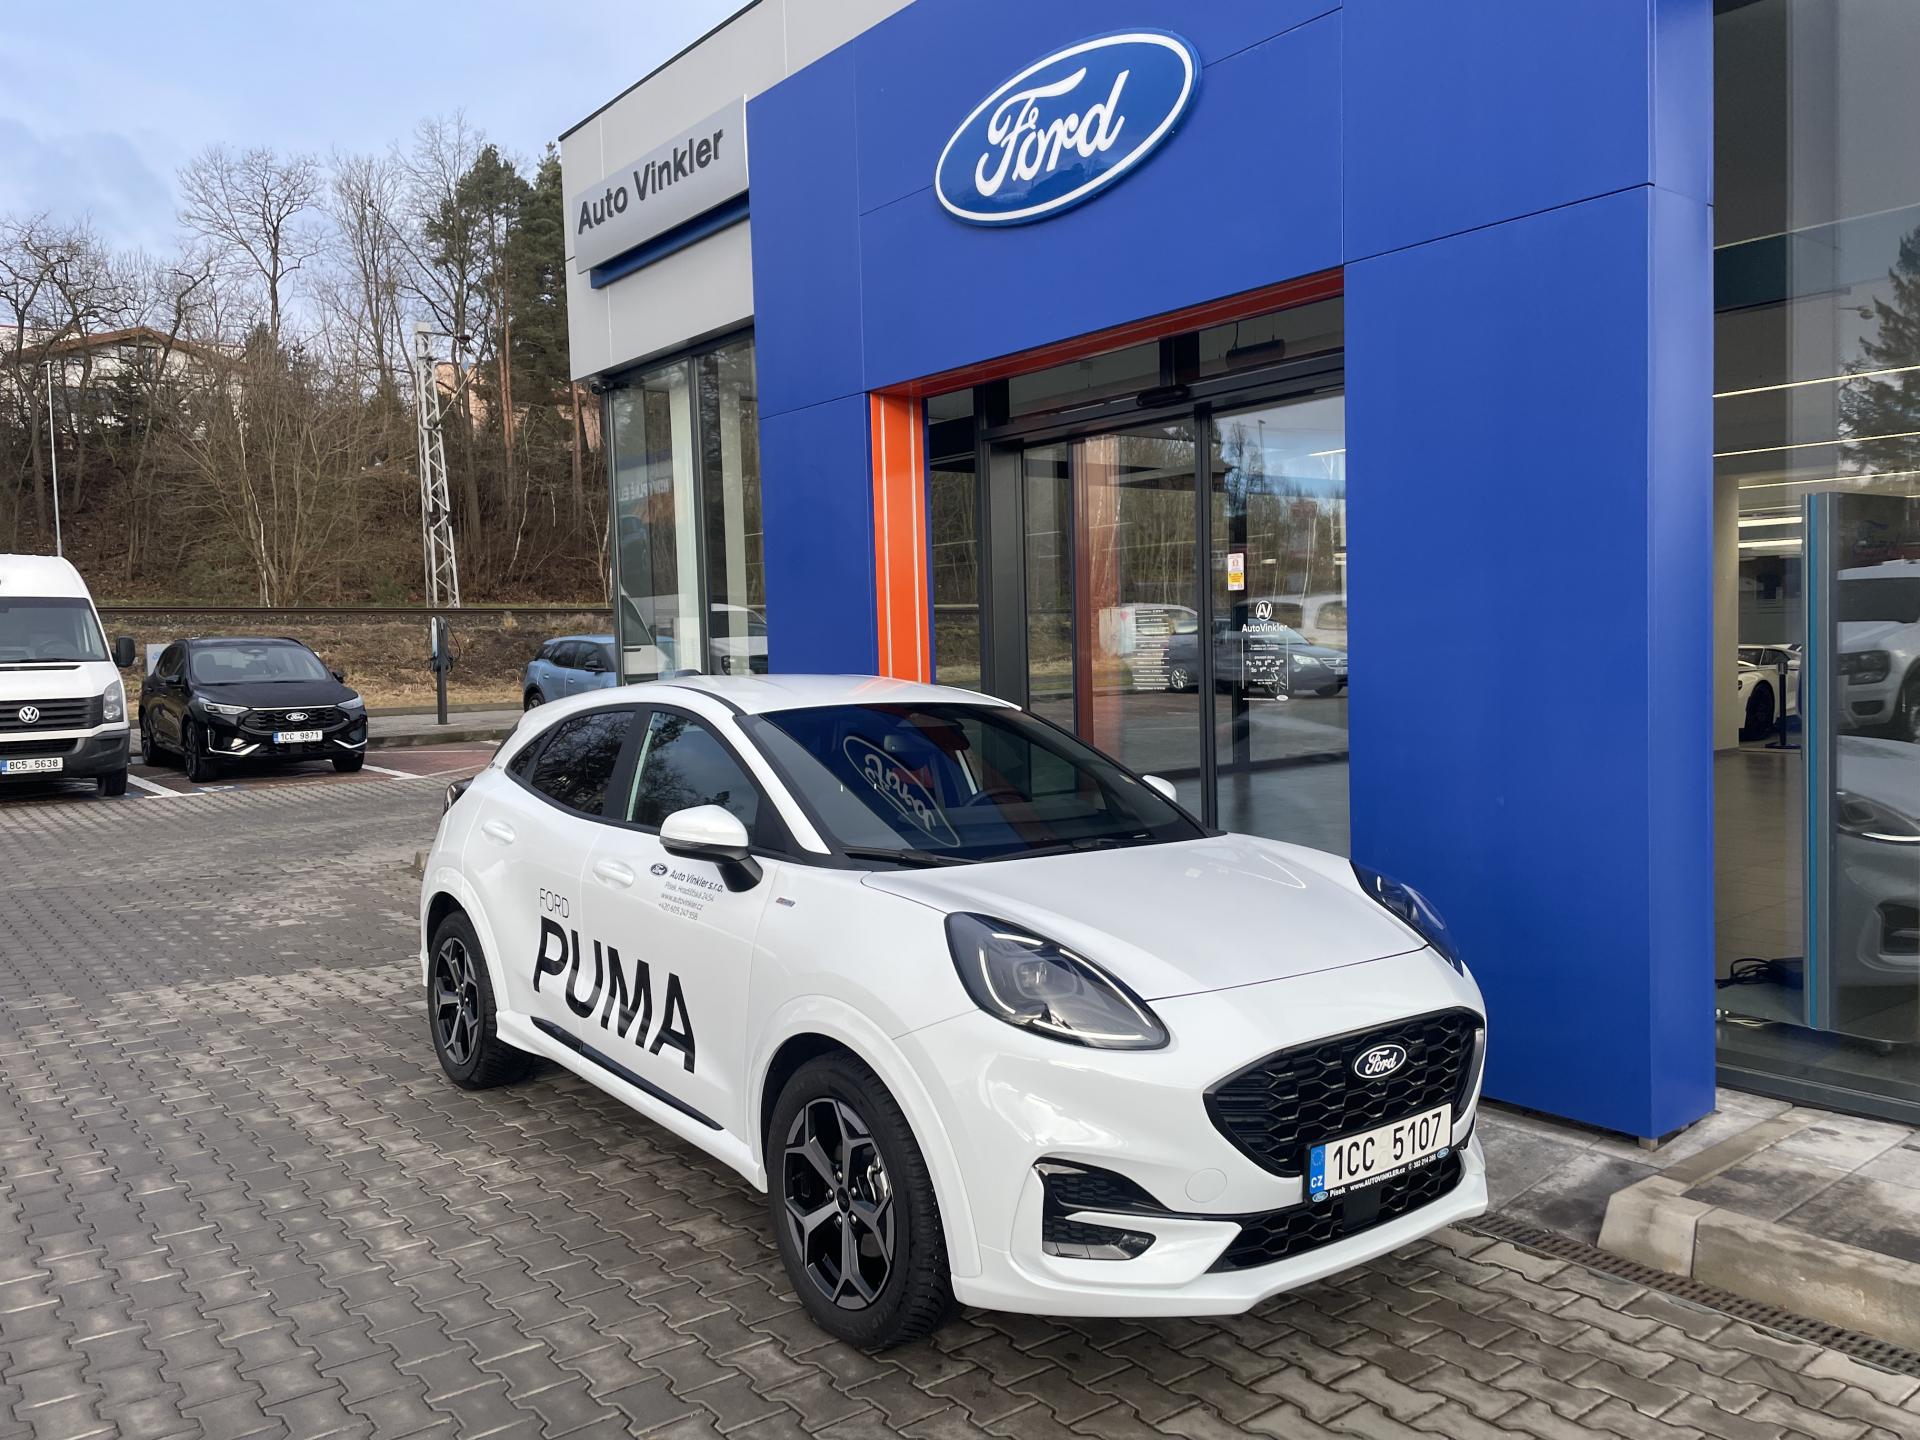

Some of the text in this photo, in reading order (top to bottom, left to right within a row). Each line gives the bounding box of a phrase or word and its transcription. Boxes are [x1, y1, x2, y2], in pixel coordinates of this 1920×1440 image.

[974, 66, 1130, 197] Ford
[578, 128, 724, 235] Auto Vinkler
[1241, 623, 1287, 633] AutoVinkler
[299, 731, 319, 739] 9871
[9, 759, 58, 769] 8C5 5638
[669, 870, 723, 893] Auto Vinkler s.r.o.
[539, 888, 570, 918] FORD
[532, 915, 697, 1075] PUMA
[1365, 1049, 1398, 1075] Ford
[1333, 1111, 1442, 1180] 1CC 5107
[1311, 1175, 1323, 1188] CZ
